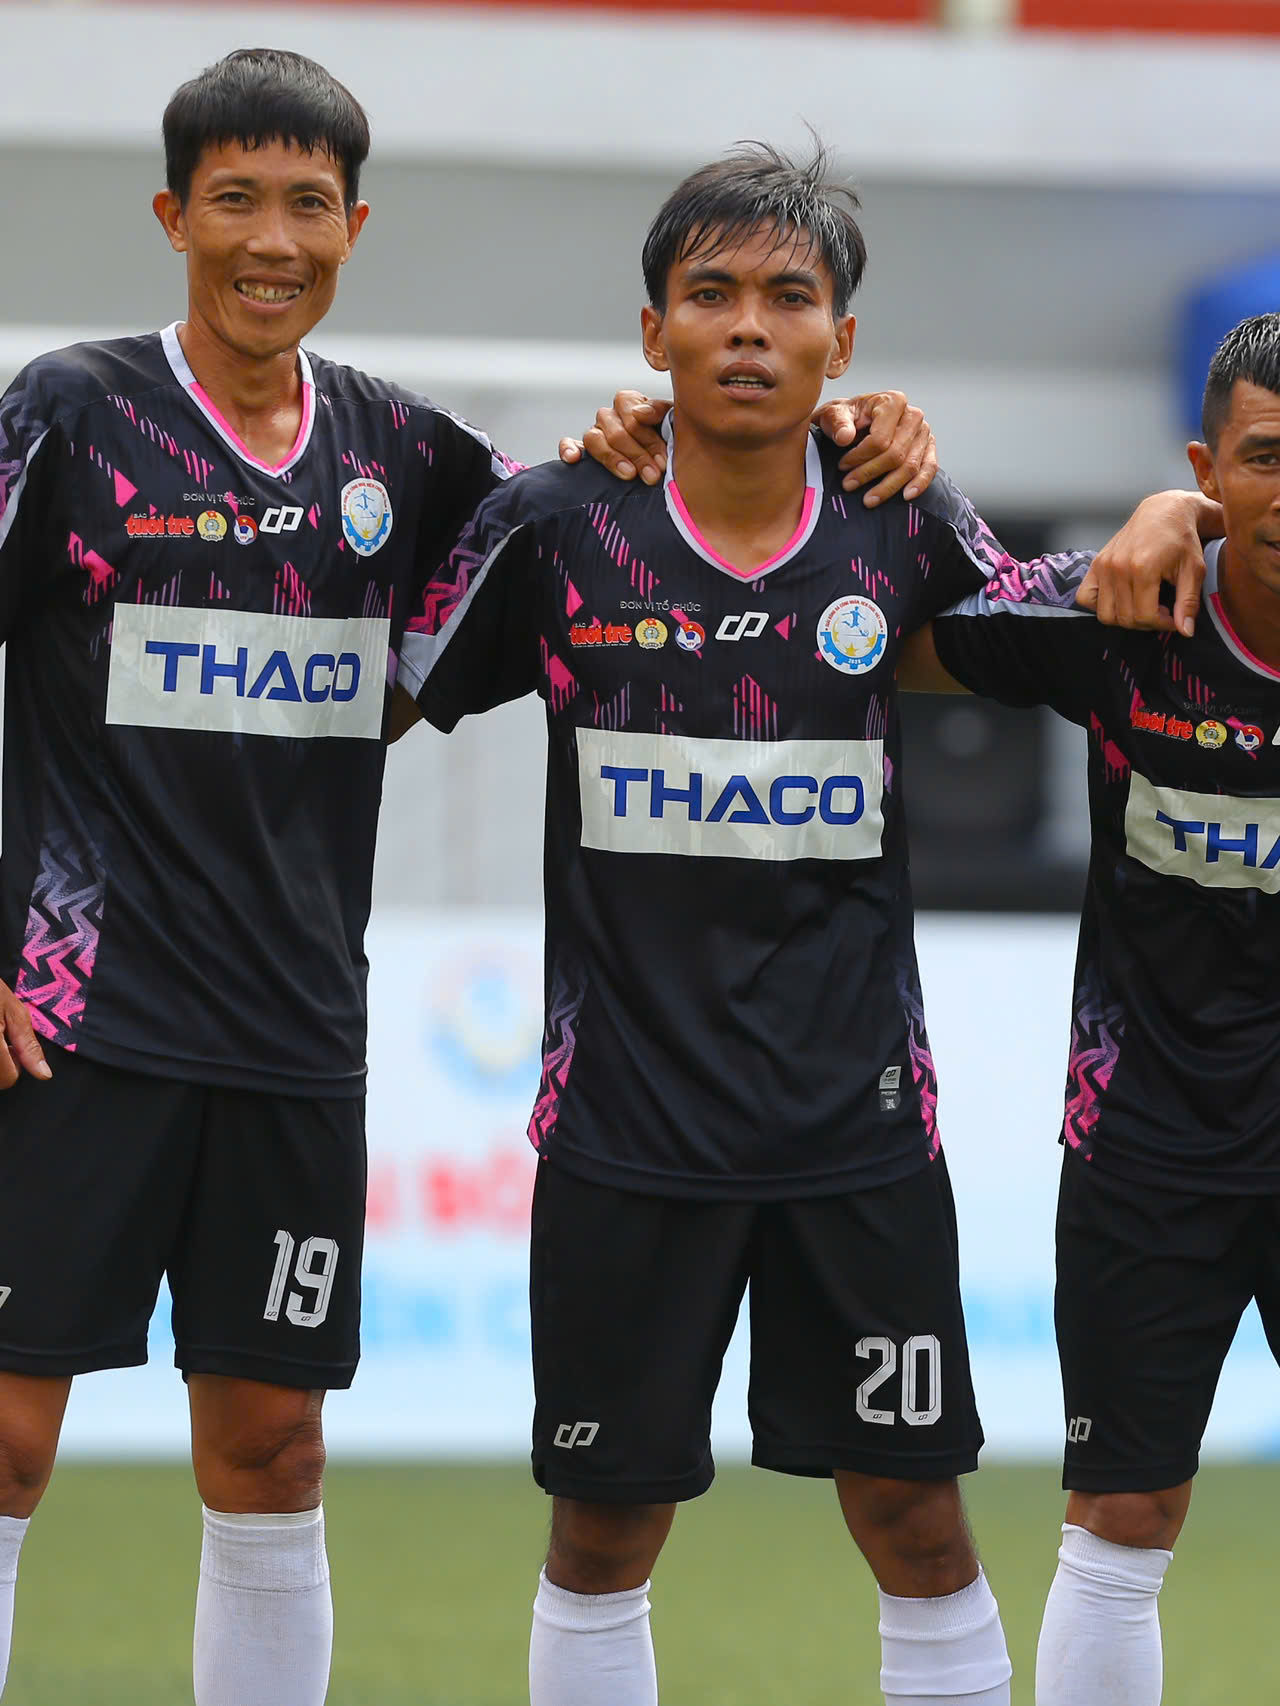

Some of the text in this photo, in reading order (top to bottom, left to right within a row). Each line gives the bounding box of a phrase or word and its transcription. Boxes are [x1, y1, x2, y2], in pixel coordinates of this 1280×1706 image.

[620, 600, 643, 610] ĐƠN
[656, 599, 670, 611] TỔ
[146, 640, 361, 703] THACO
[601, 765, 865, 826] THACO
[263, 1229, 340, 1328] 19
[855, 1333, 942, 1426] 20
